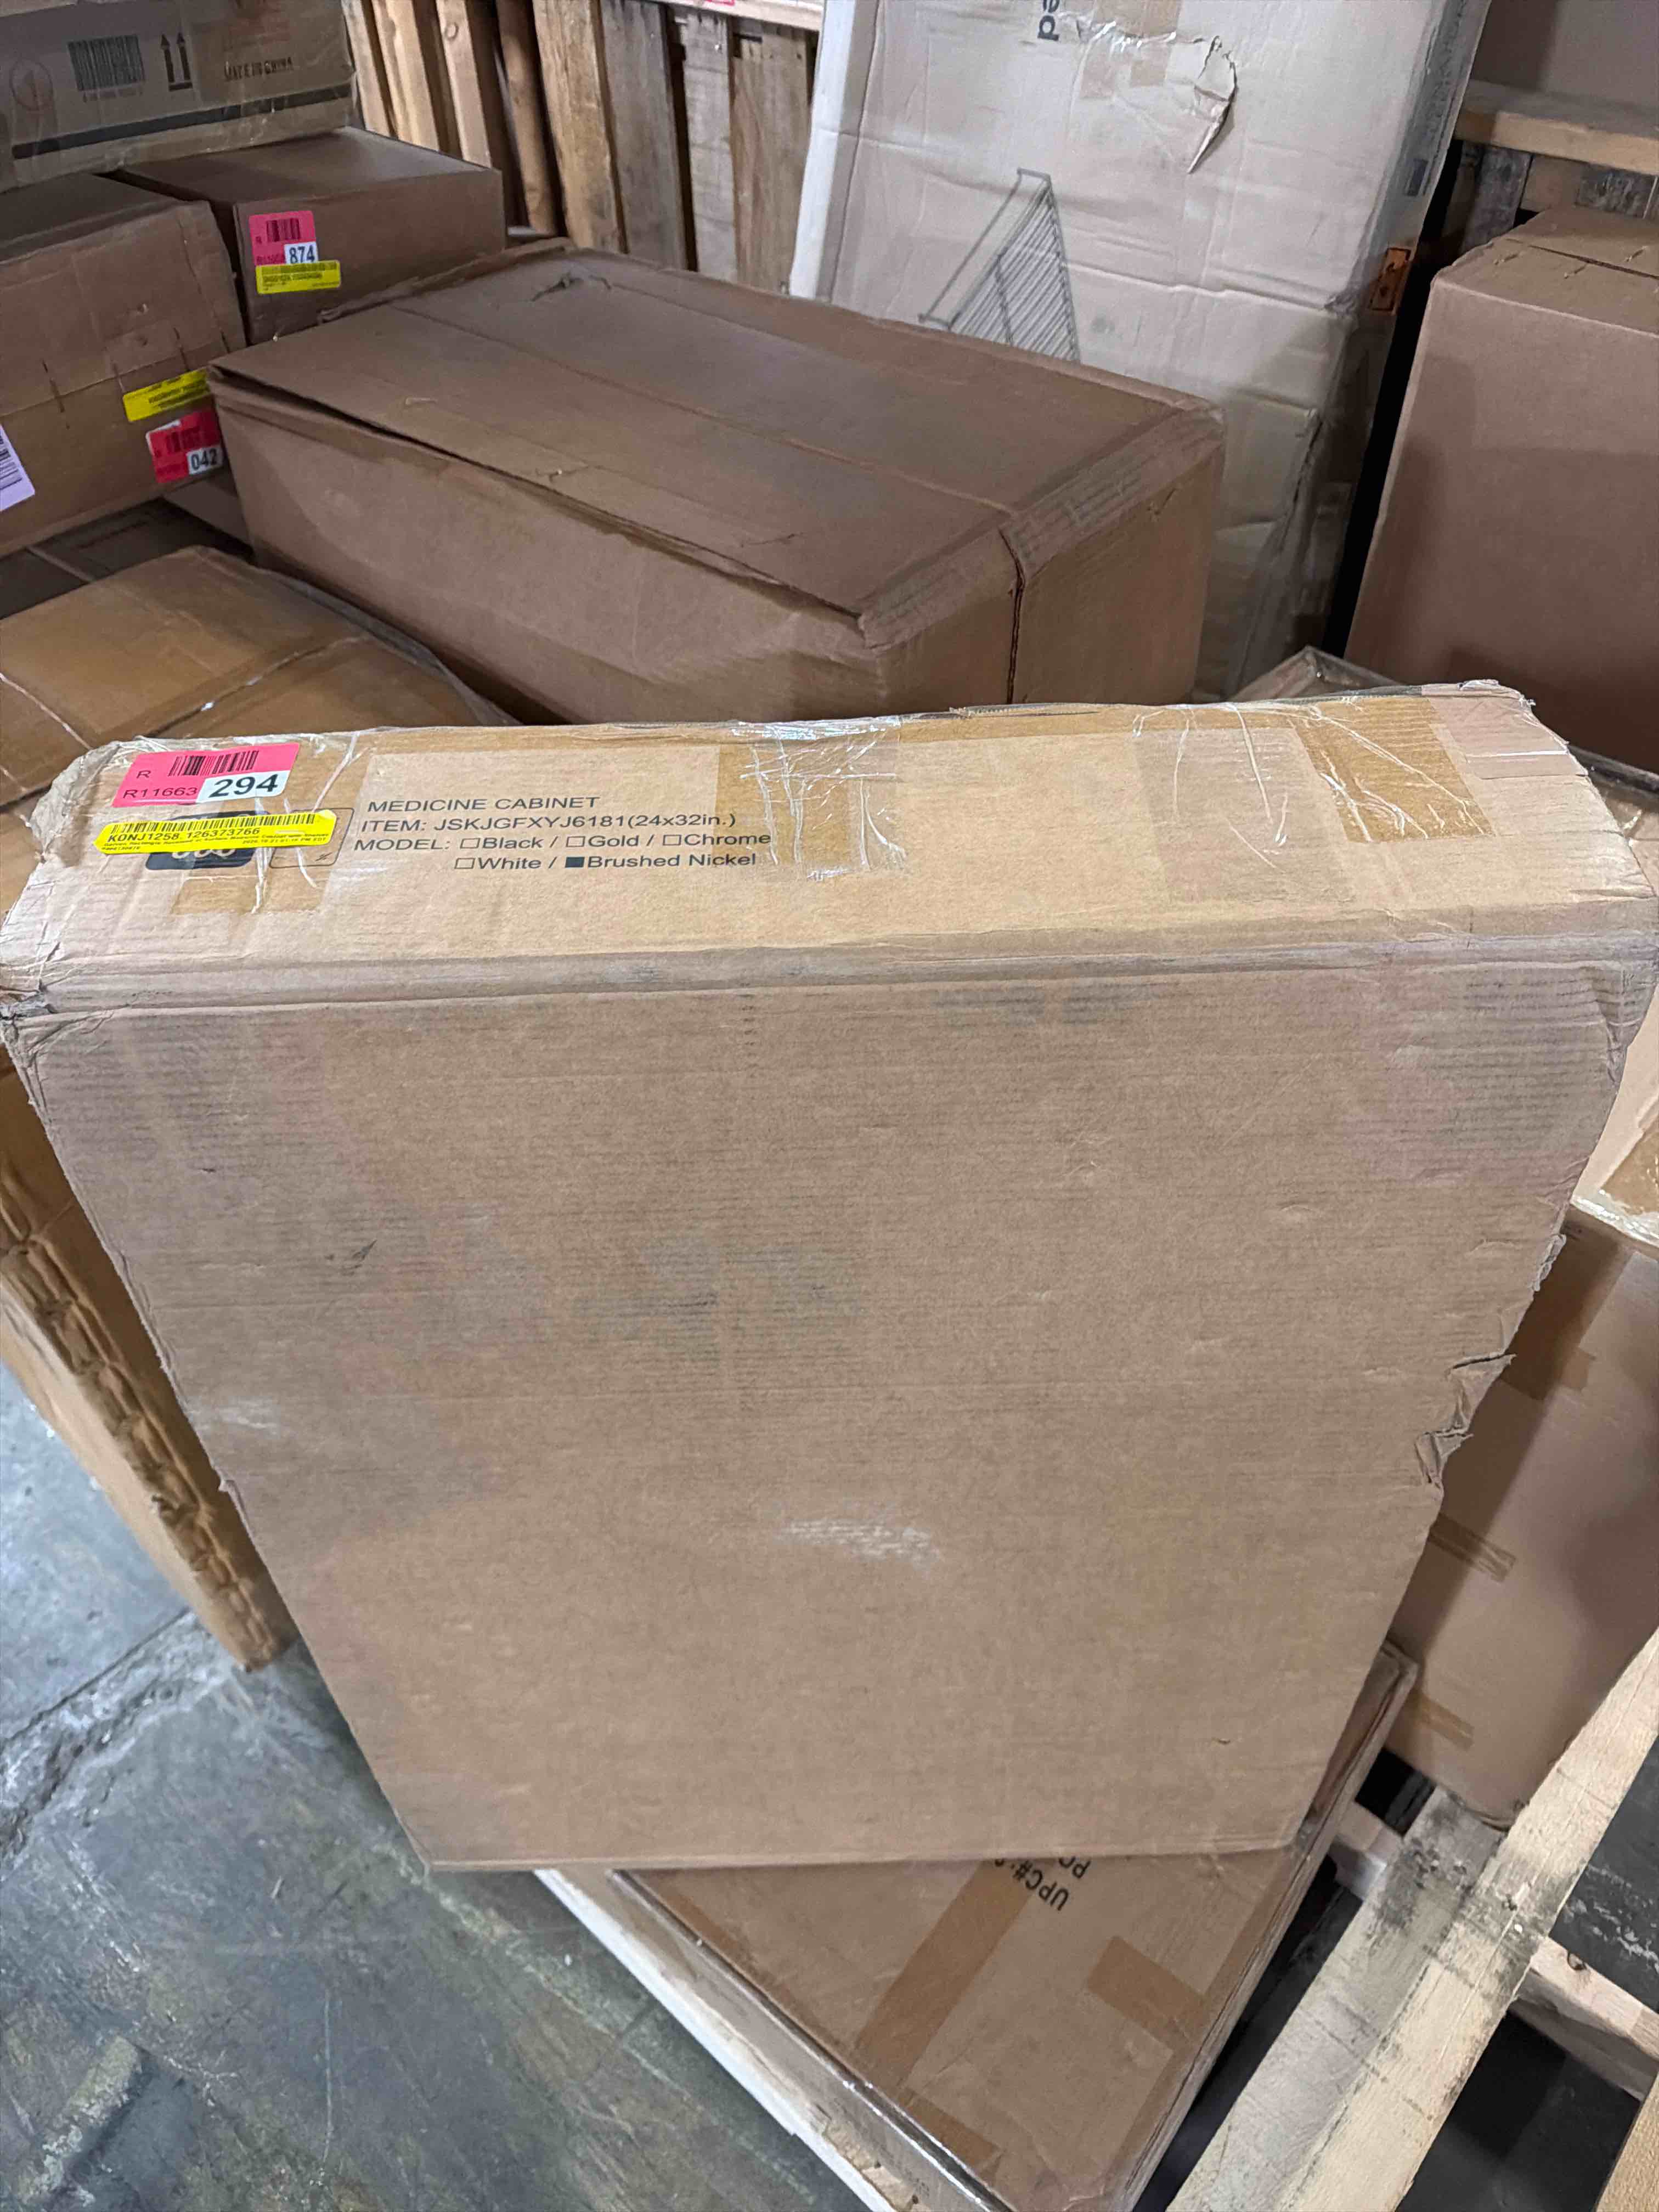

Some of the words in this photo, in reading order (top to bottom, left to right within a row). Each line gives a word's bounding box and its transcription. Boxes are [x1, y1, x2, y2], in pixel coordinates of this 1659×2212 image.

[289, 245, 315, 264] 874
[190, 448, 217, 470] 042
[137, 770, 151, 779] R
[122, 787, 198, 799] R11663
[208, 774, 279, 798] 294
[368, 798, 488, 812] MEDICINE
[495, 797, 601, 810] CABINET
[362, 819, 427, 832] ITEM:
[434, 813, 736, 831] JSKJGFXYJ6181(24x32in.)
[354, 839, 450, 851] MODEL:
[689, 853, 756, 866] Nickel
